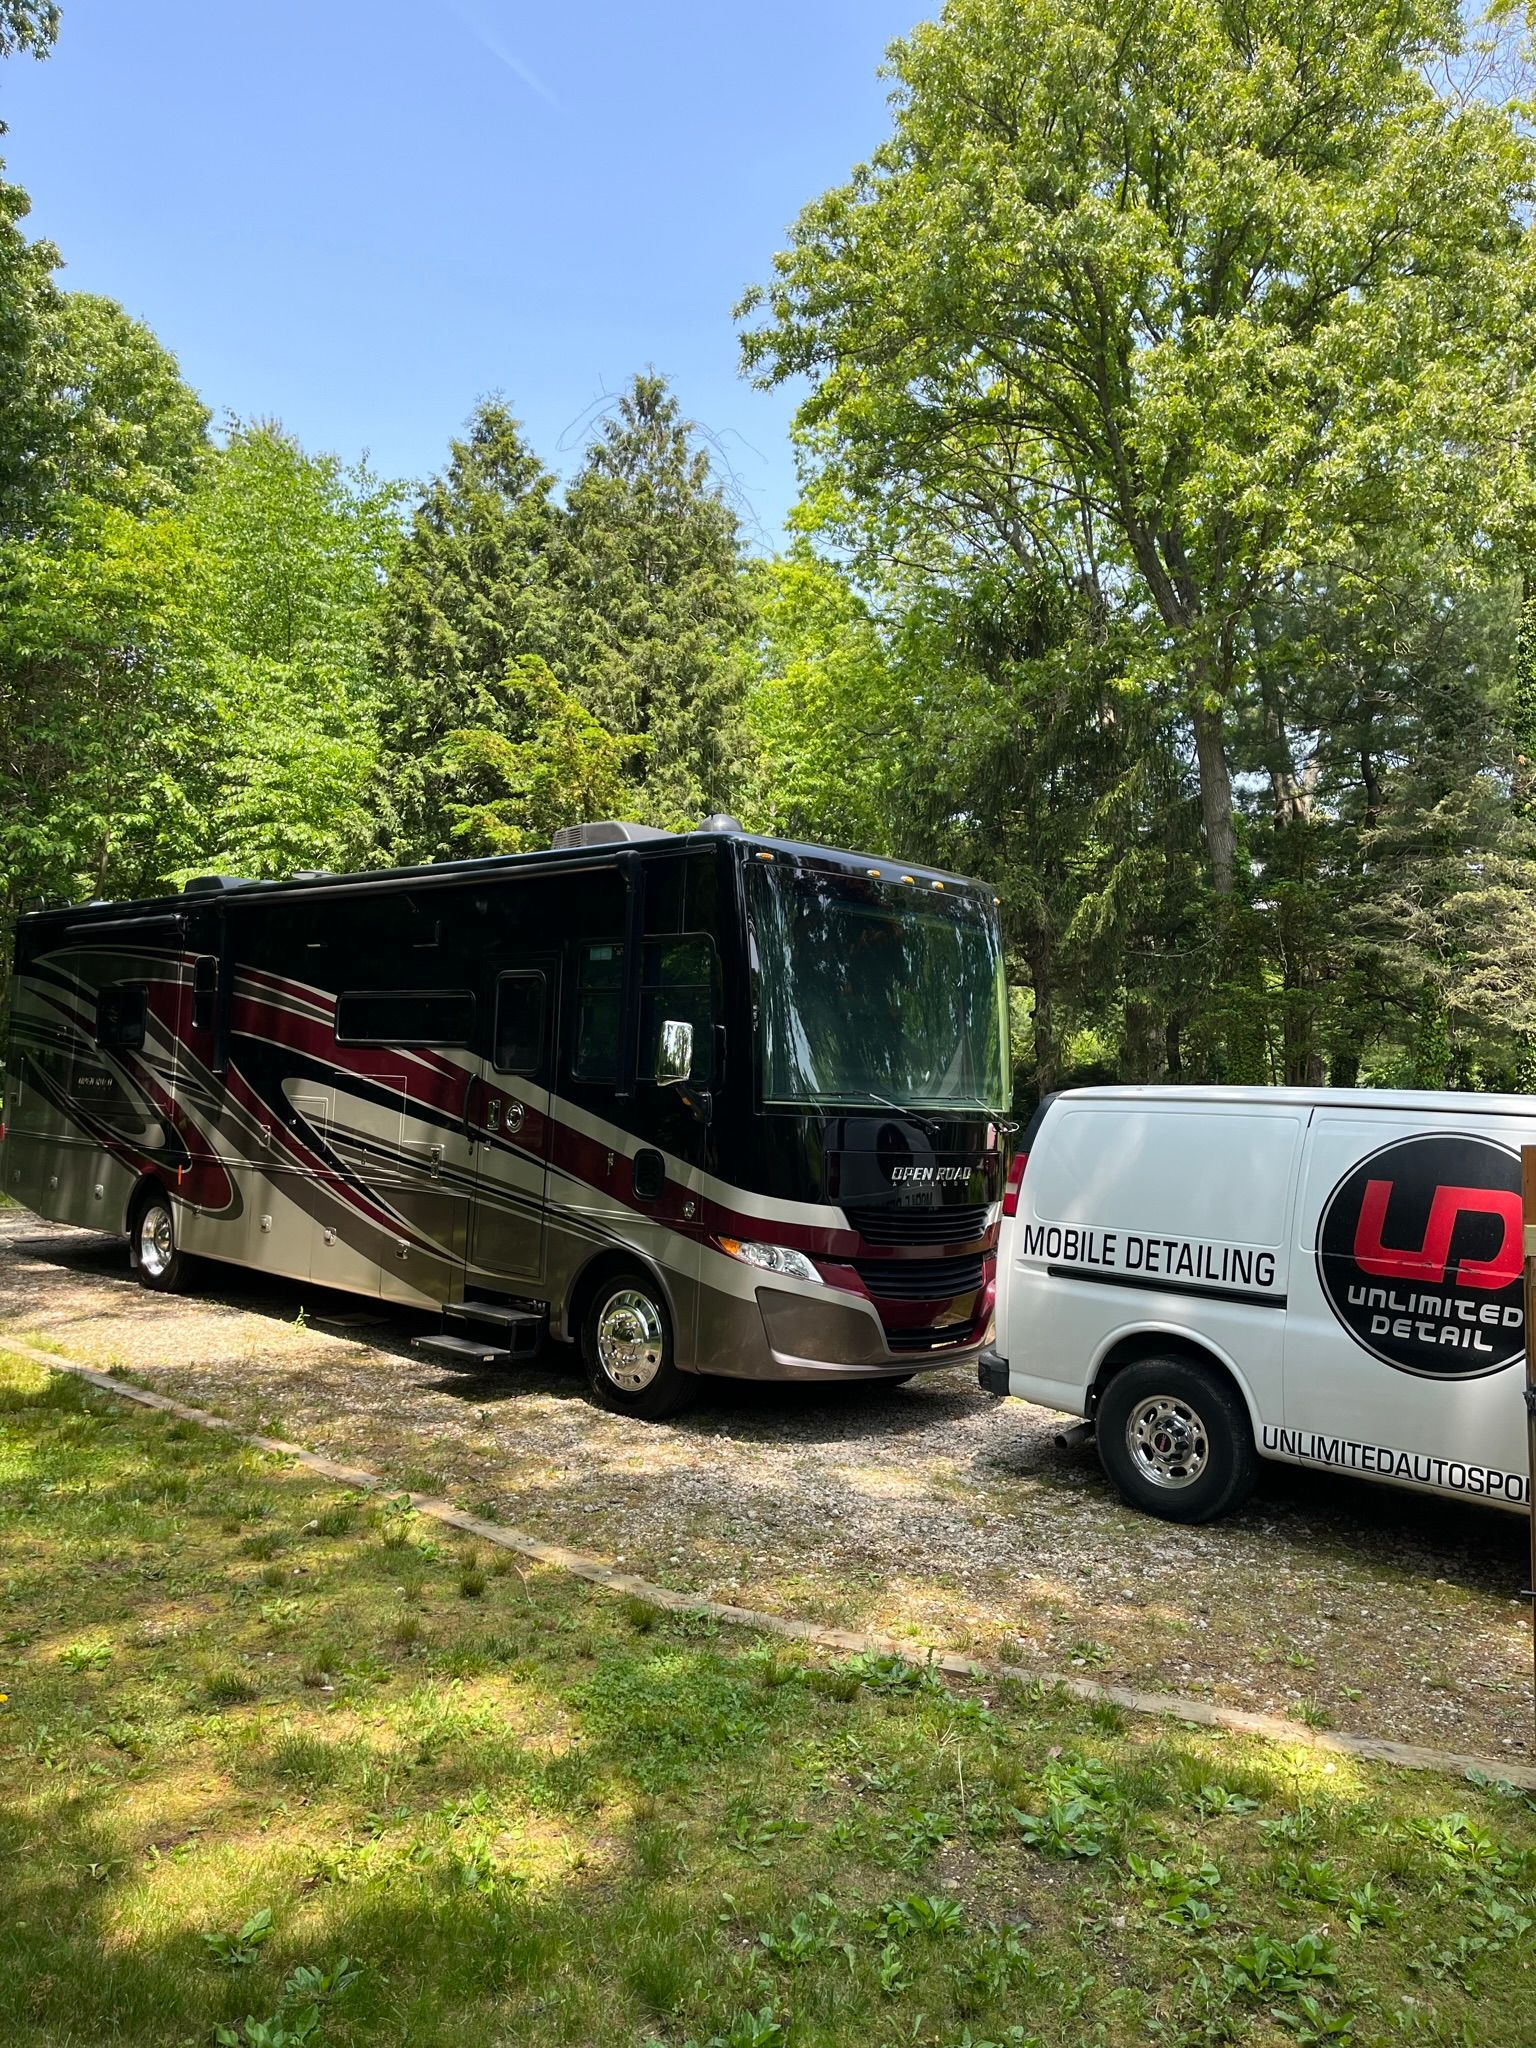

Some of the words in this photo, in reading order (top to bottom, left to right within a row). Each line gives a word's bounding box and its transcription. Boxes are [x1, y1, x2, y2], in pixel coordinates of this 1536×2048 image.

[891, 1166, 934, 1181] OPEN
[935, 1166, 972, 1181] ROAD
[1023, 1224, 1117, 1266] MOBILE
[1125, 1236, 1276, 1287] DETAILING
[1347, 1285, 1524, 1328] UNLIMITED
[1370, 1314, 1493, 1352] DETAIL
[1263, 1425, 1530, 1503] UNLIMITEDAUTOSPO
